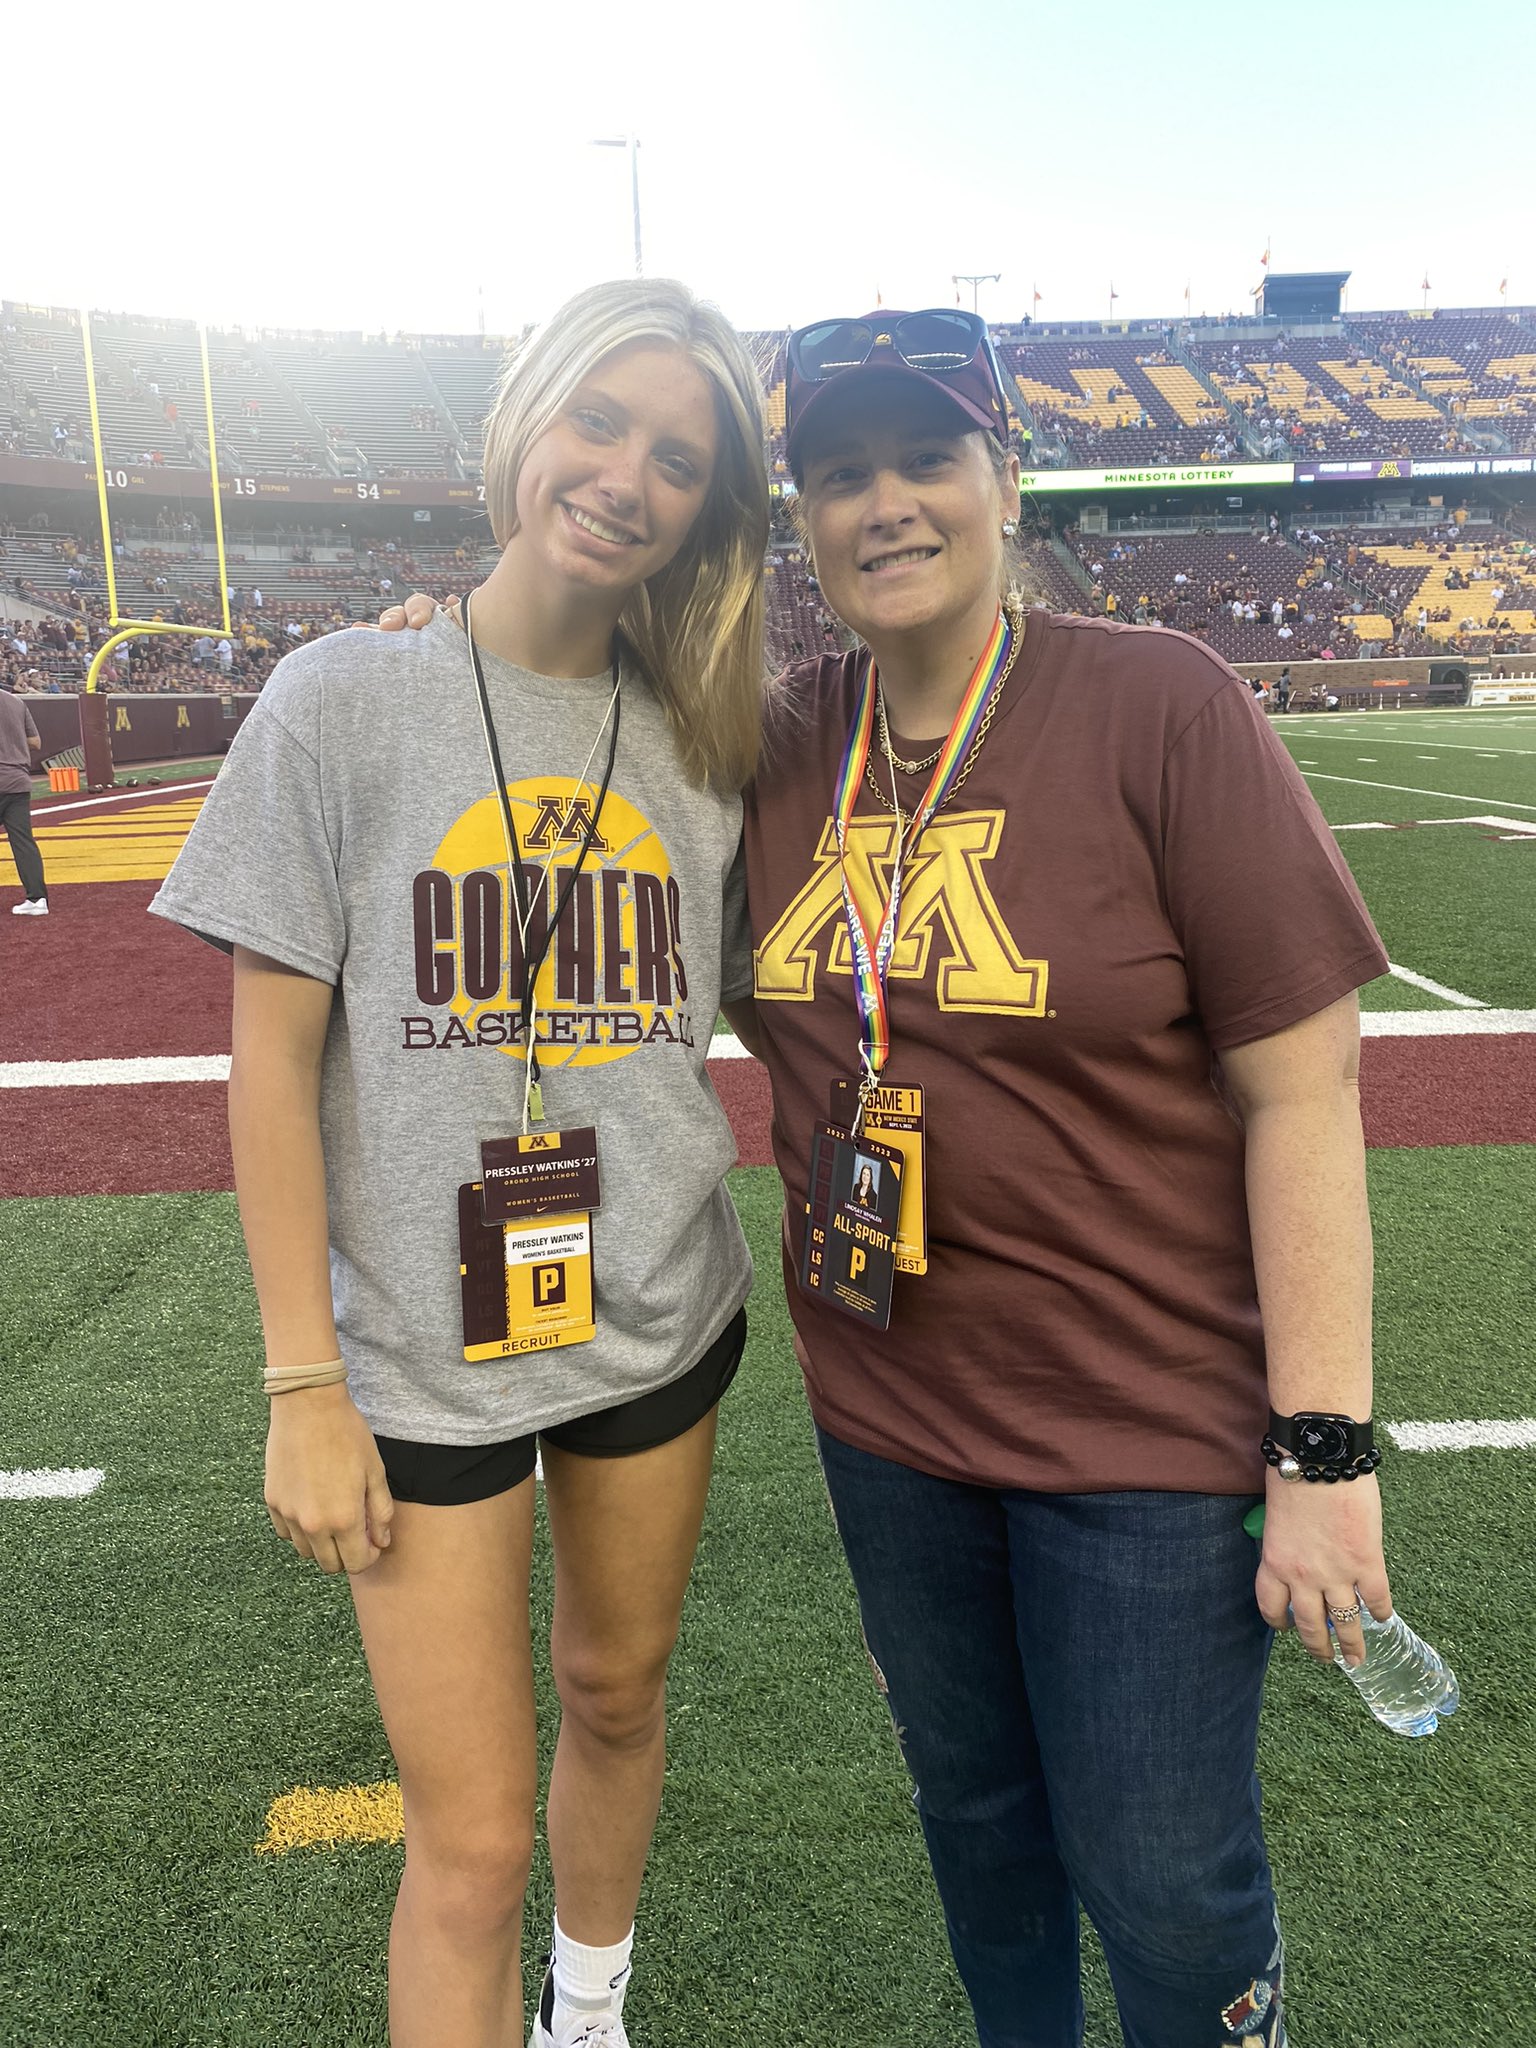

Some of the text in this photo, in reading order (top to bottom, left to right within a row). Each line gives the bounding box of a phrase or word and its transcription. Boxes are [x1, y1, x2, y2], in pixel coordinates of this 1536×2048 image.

[105, 470, 127, 487] 10
[234, 478, 257, 495] 15
[1022, 470, 1234, 486] RY MINNESOTA LOTTERY
[357, 483, 380, 499] 54
[847, 903, 864, 942] ARE
[413, 863, 689, 1007] GOPHERS
[855, 946, 872, 976] WE
[866, 1089, 915, 1113] GAME 1
[826, 1127, 846, 1140] 2022
[870, 1144, 891, 1157] 2023
[485, 1156, 597, 1179] PRESSLEY WATKINS '27
[504, 1177, 530, 1186] ORONO
[552, 1171, 580, 1180] SCHOOL
[506, 1192, 580, 1207] WOMEN'S BASKETBALL
[844, 1202, 863, 1215] LINDSAY
[863, 1210, 883, 1224] WHALEN
[512, 1232, 584, 1250] PRESSLEY WATKINS
[813, 1228, 825, 1244] CC
[833, 1213, 891, 1252] ALL-SPORT
[522, 1246, 575, 1259] WOMEN'S BASKETBALL
[811, 1249, 822, 1266] LS
[849, 1245, 867, 1280] P
[895, 1257, 921, 1272] UEST
[539, 1267, 560, 1302] P
[810, 1271, 820, 1287] IC
[502, 1333, 561, 1353] RECRUIT
